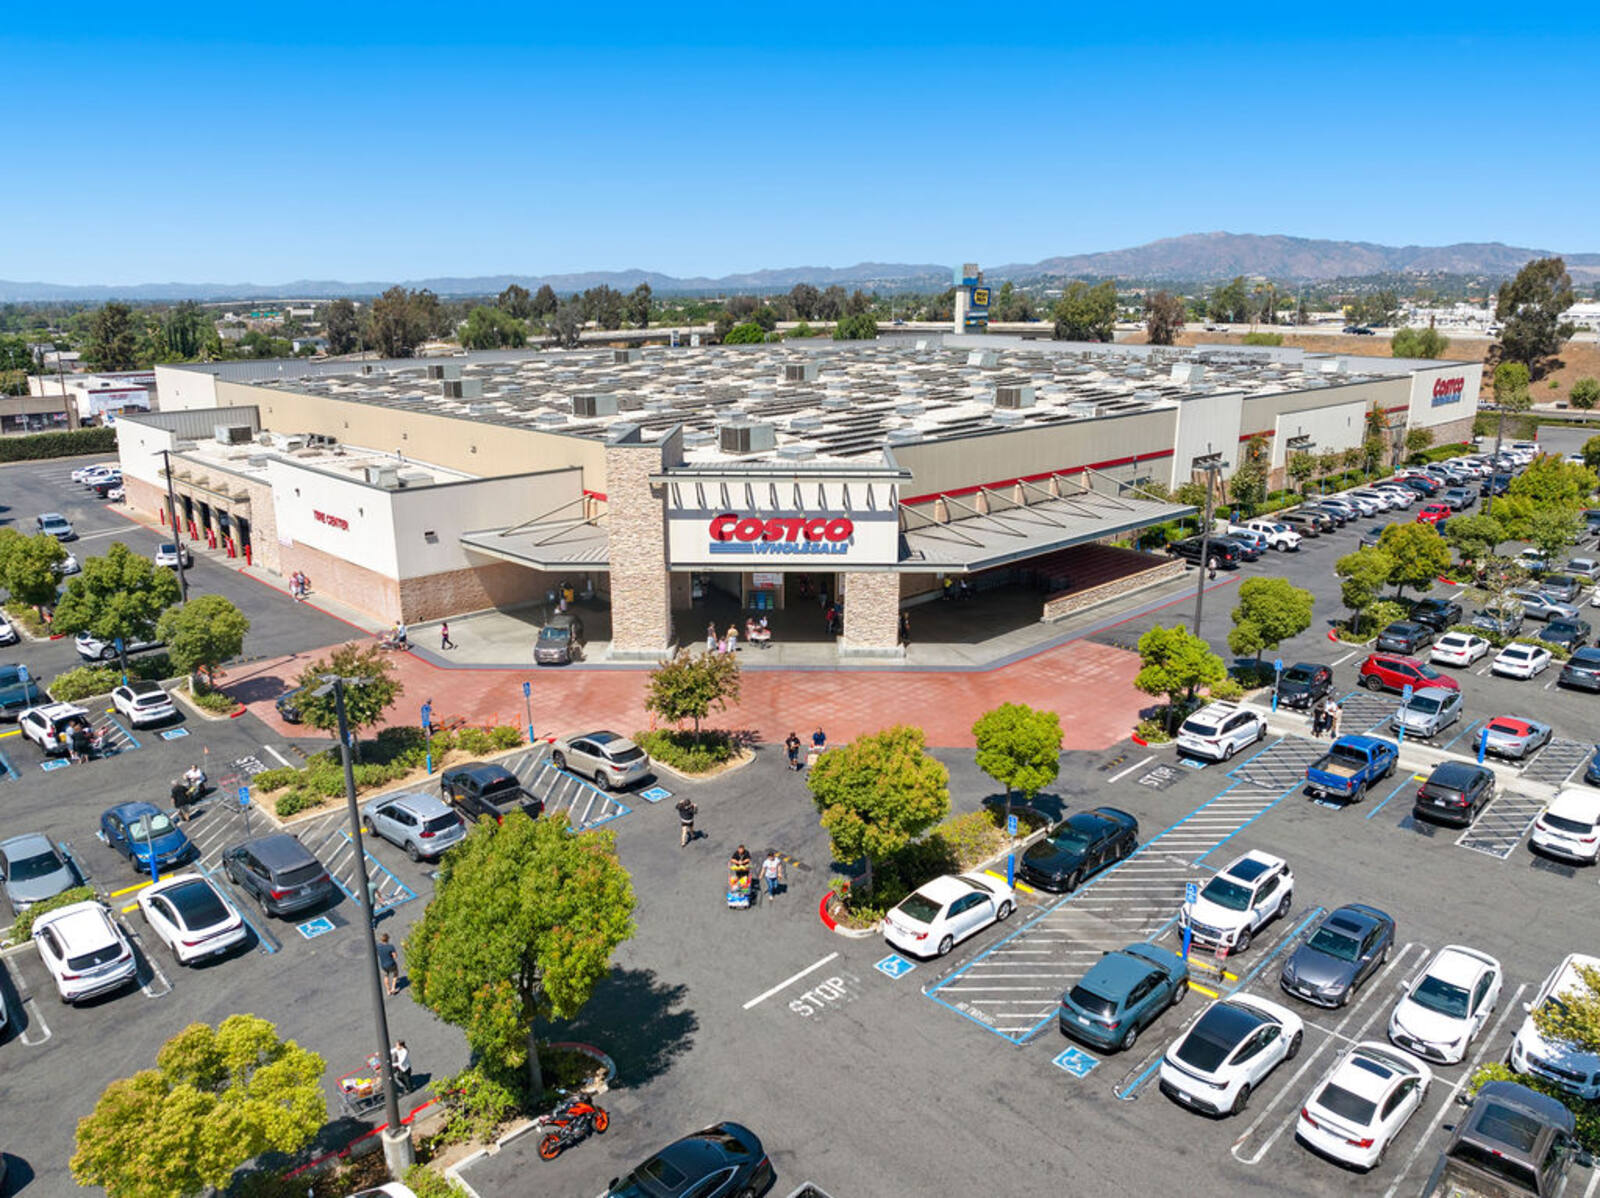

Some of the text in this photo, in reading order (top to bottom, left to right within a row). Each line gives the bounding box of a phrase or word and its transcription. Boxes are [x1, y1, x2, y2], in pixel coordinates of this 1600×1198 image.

[709, 513, 854, 542] COSTCO
[753, 542, 849, 554] WHOLESALE
[789, 976, 847, 1017] STOP
